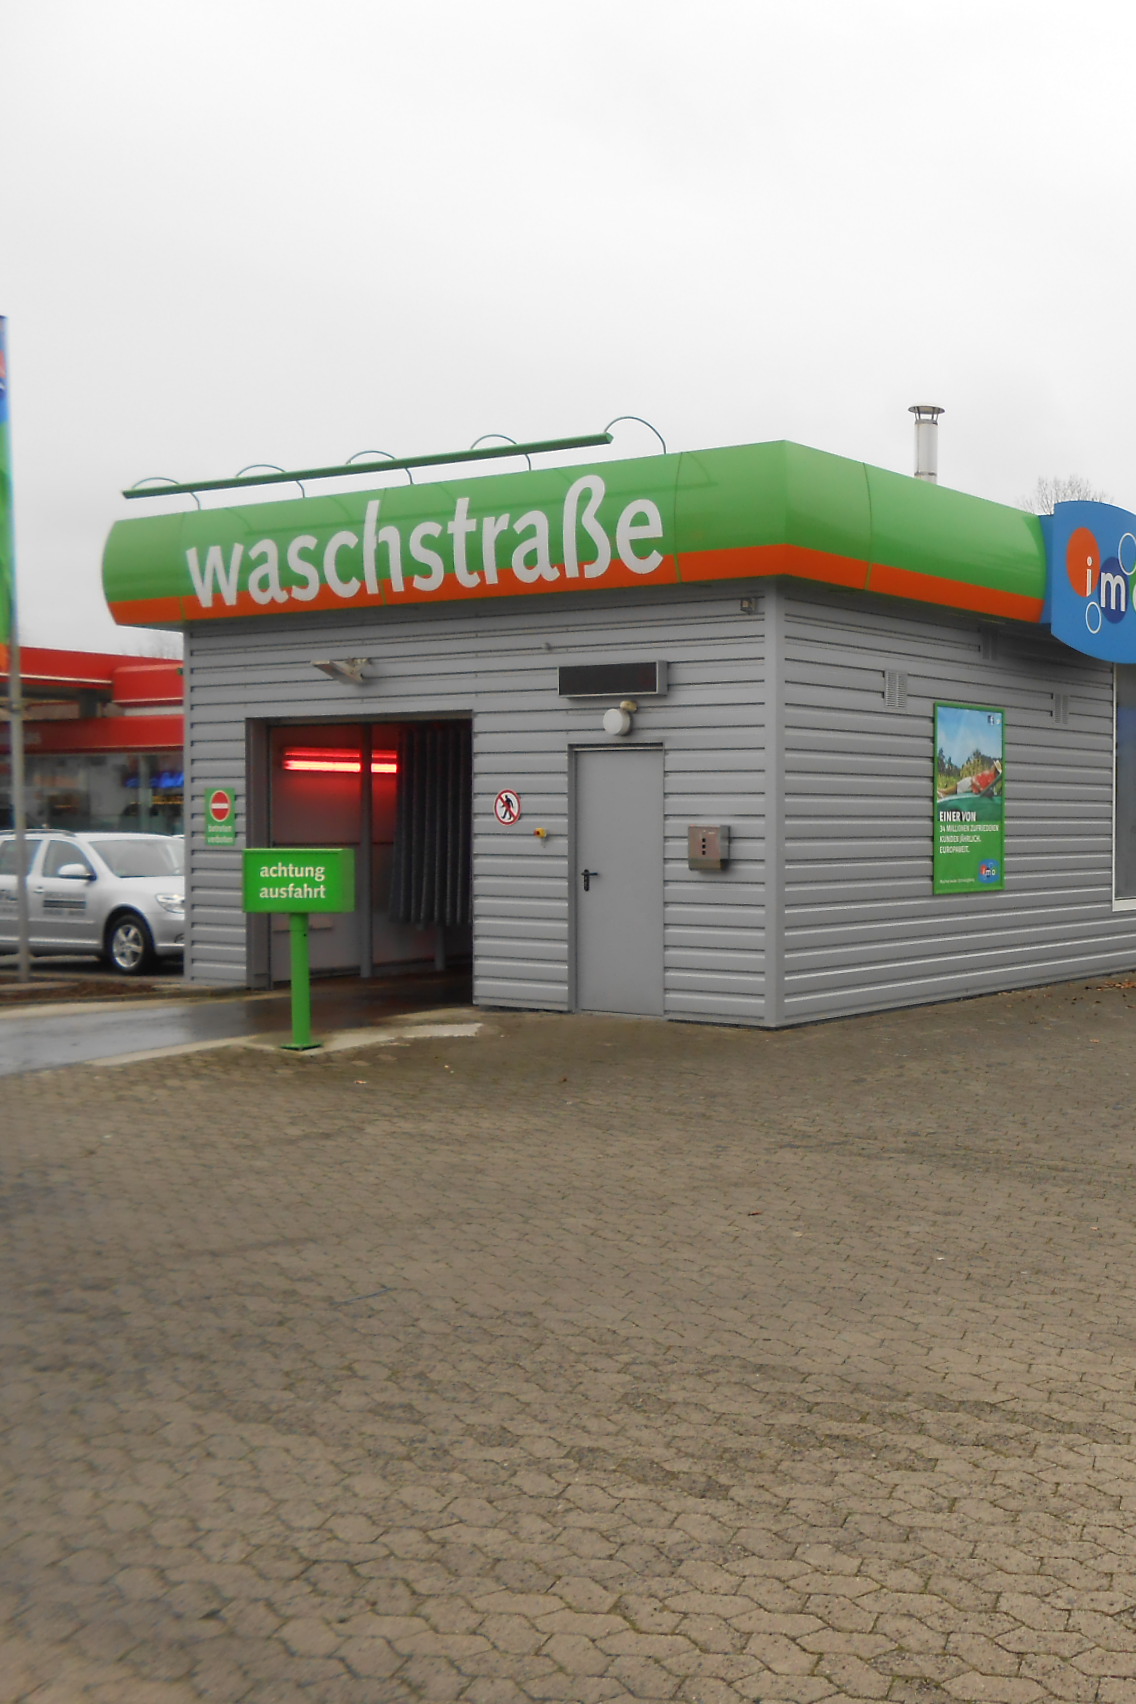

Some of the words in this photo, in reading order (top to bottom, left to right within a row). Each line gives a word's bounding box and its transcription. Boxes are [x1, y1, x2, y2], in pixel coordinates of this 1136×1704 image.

[185, 474, 665, 609] waschstraße
[939, 811, 961, 822] EINER
[961, 811, 977, 822] VON
[259, 862, 326, 882] achtung
[259, 883, 326, 899] ausfahrt
